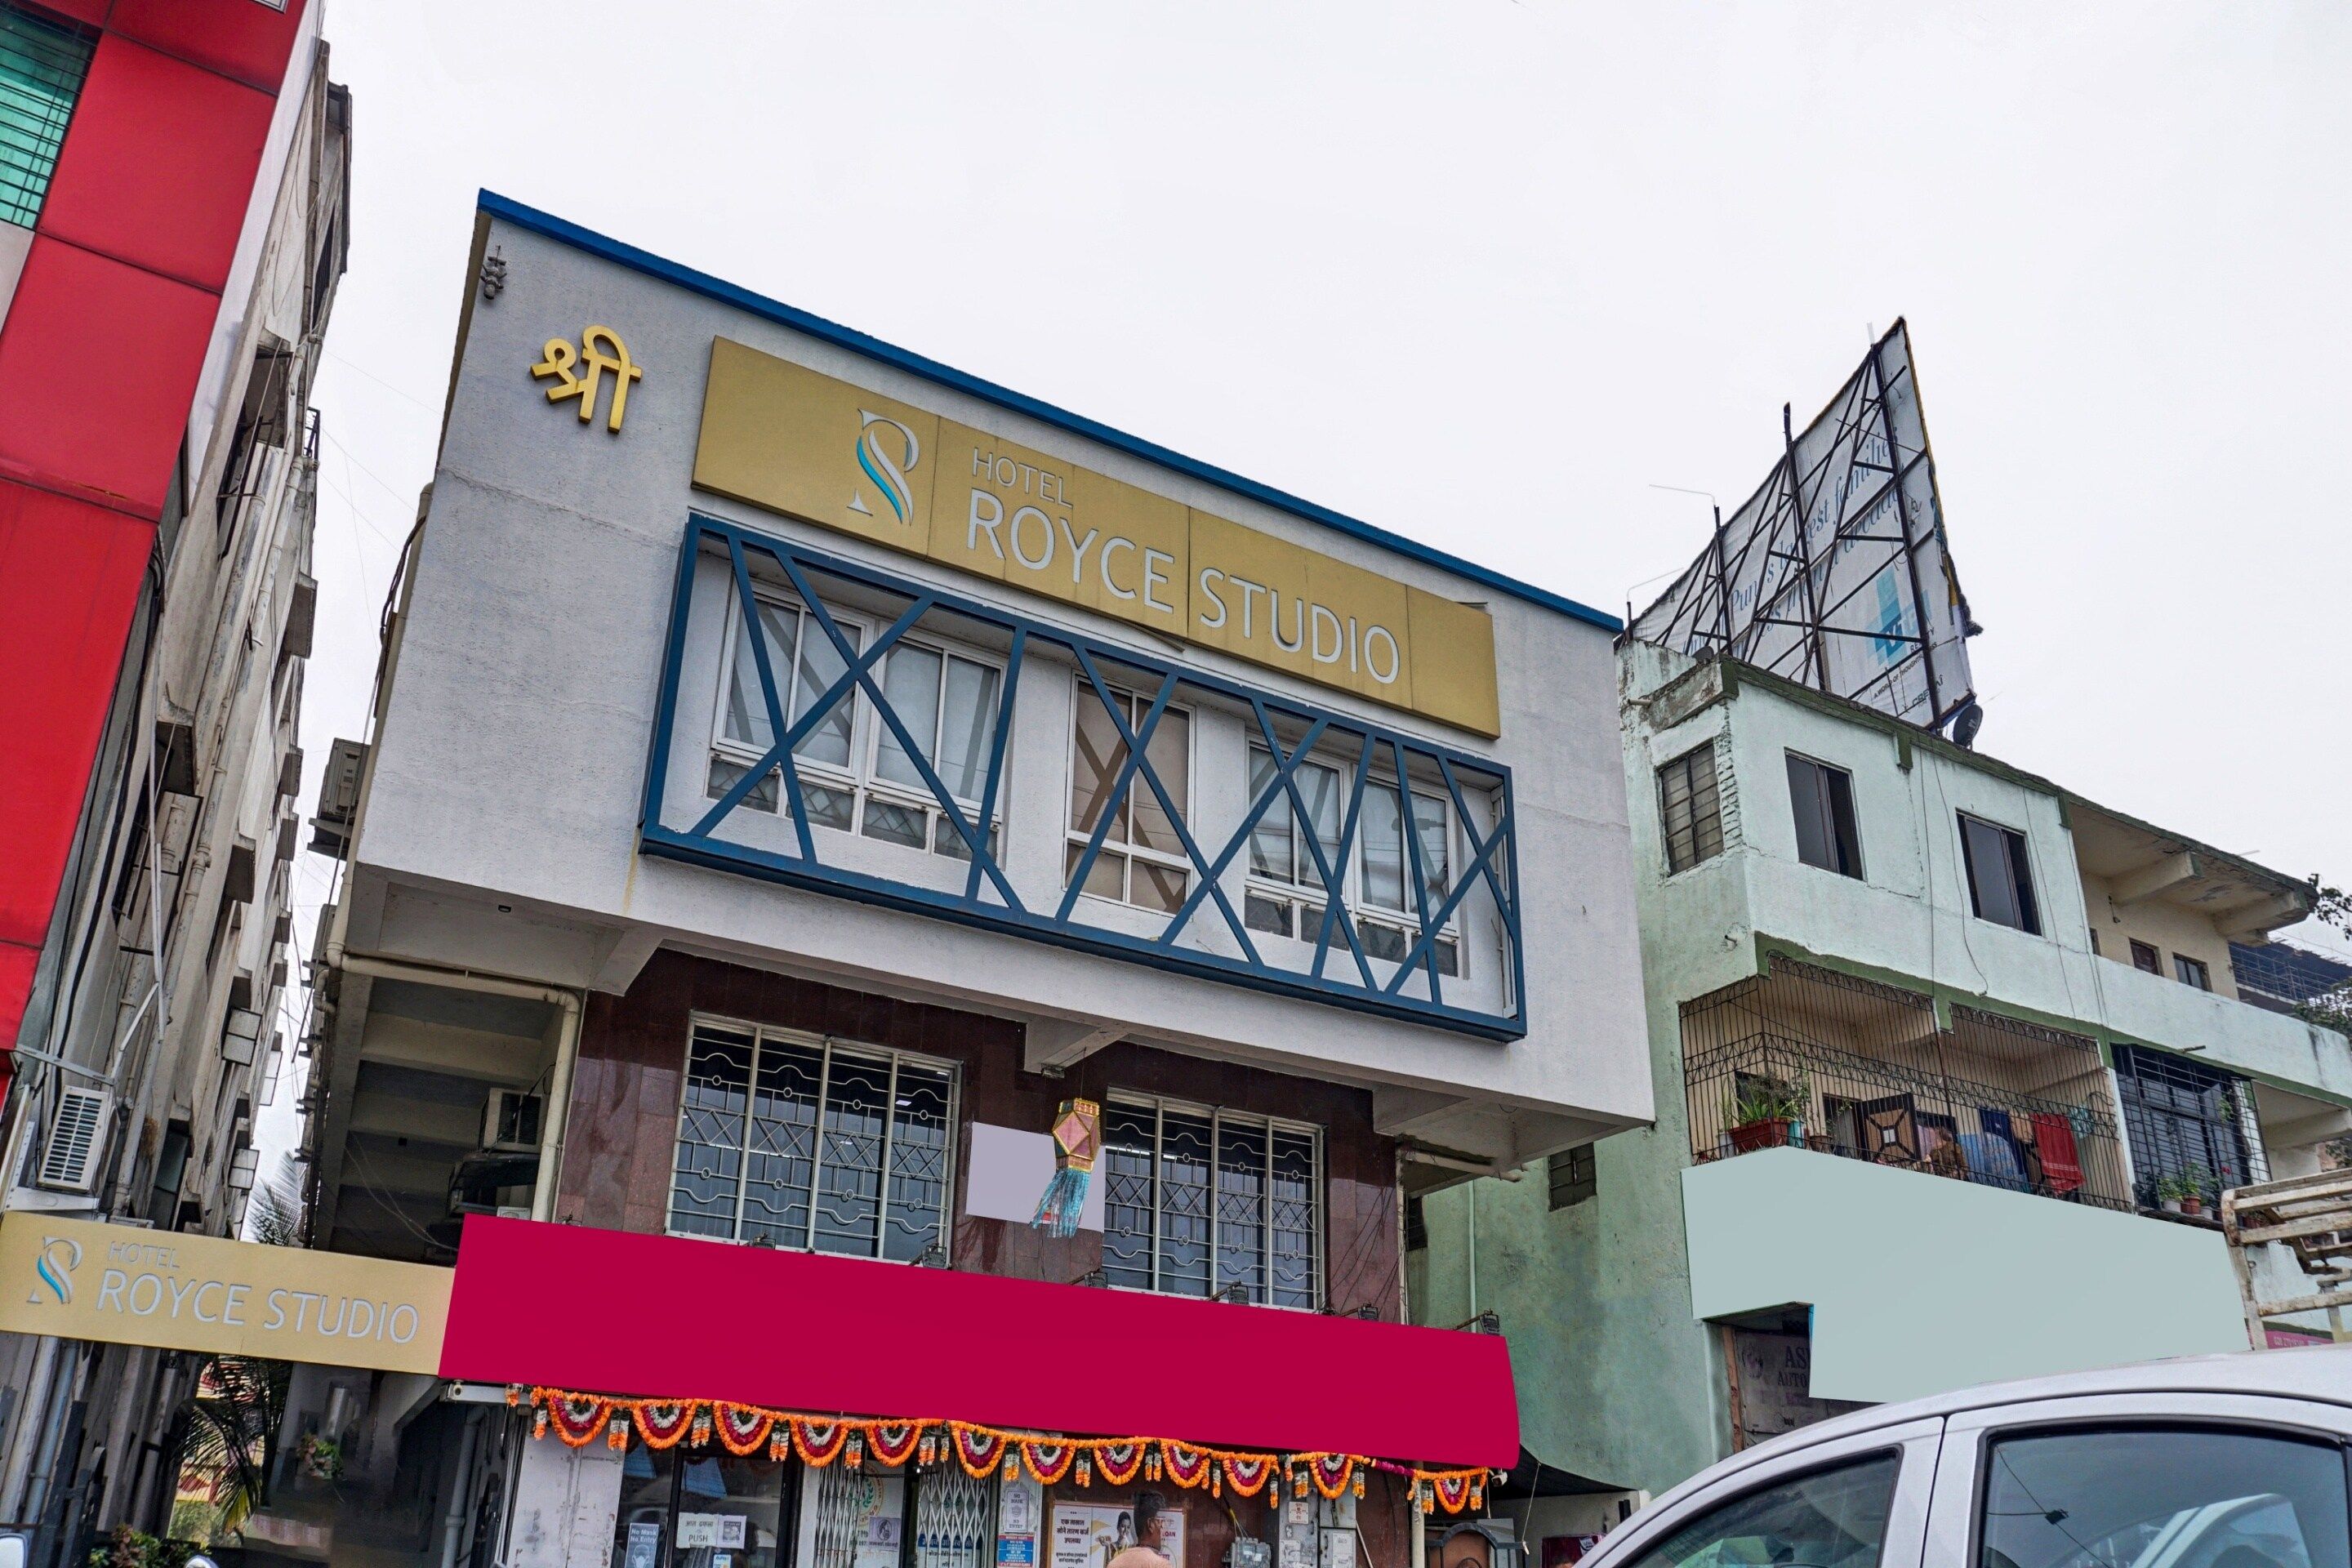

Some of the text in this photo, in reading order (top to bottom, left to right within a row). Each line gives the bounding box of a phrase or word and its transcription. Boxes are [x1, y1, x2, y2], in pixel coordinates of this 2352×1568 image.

[530, 324, 643, 434] श्री
[973, 447, 1074, 510] HOTEL
[968, 486, 1401, 685] ROYCE STUDIO
[109, 1241, 180, 1268] HOTEL
[96, 1268, 420, 1344] ROYCE STUDIO
[639, 1535, 657, 1544] Entry
[688, 1534, 708, 1543] PUSH
